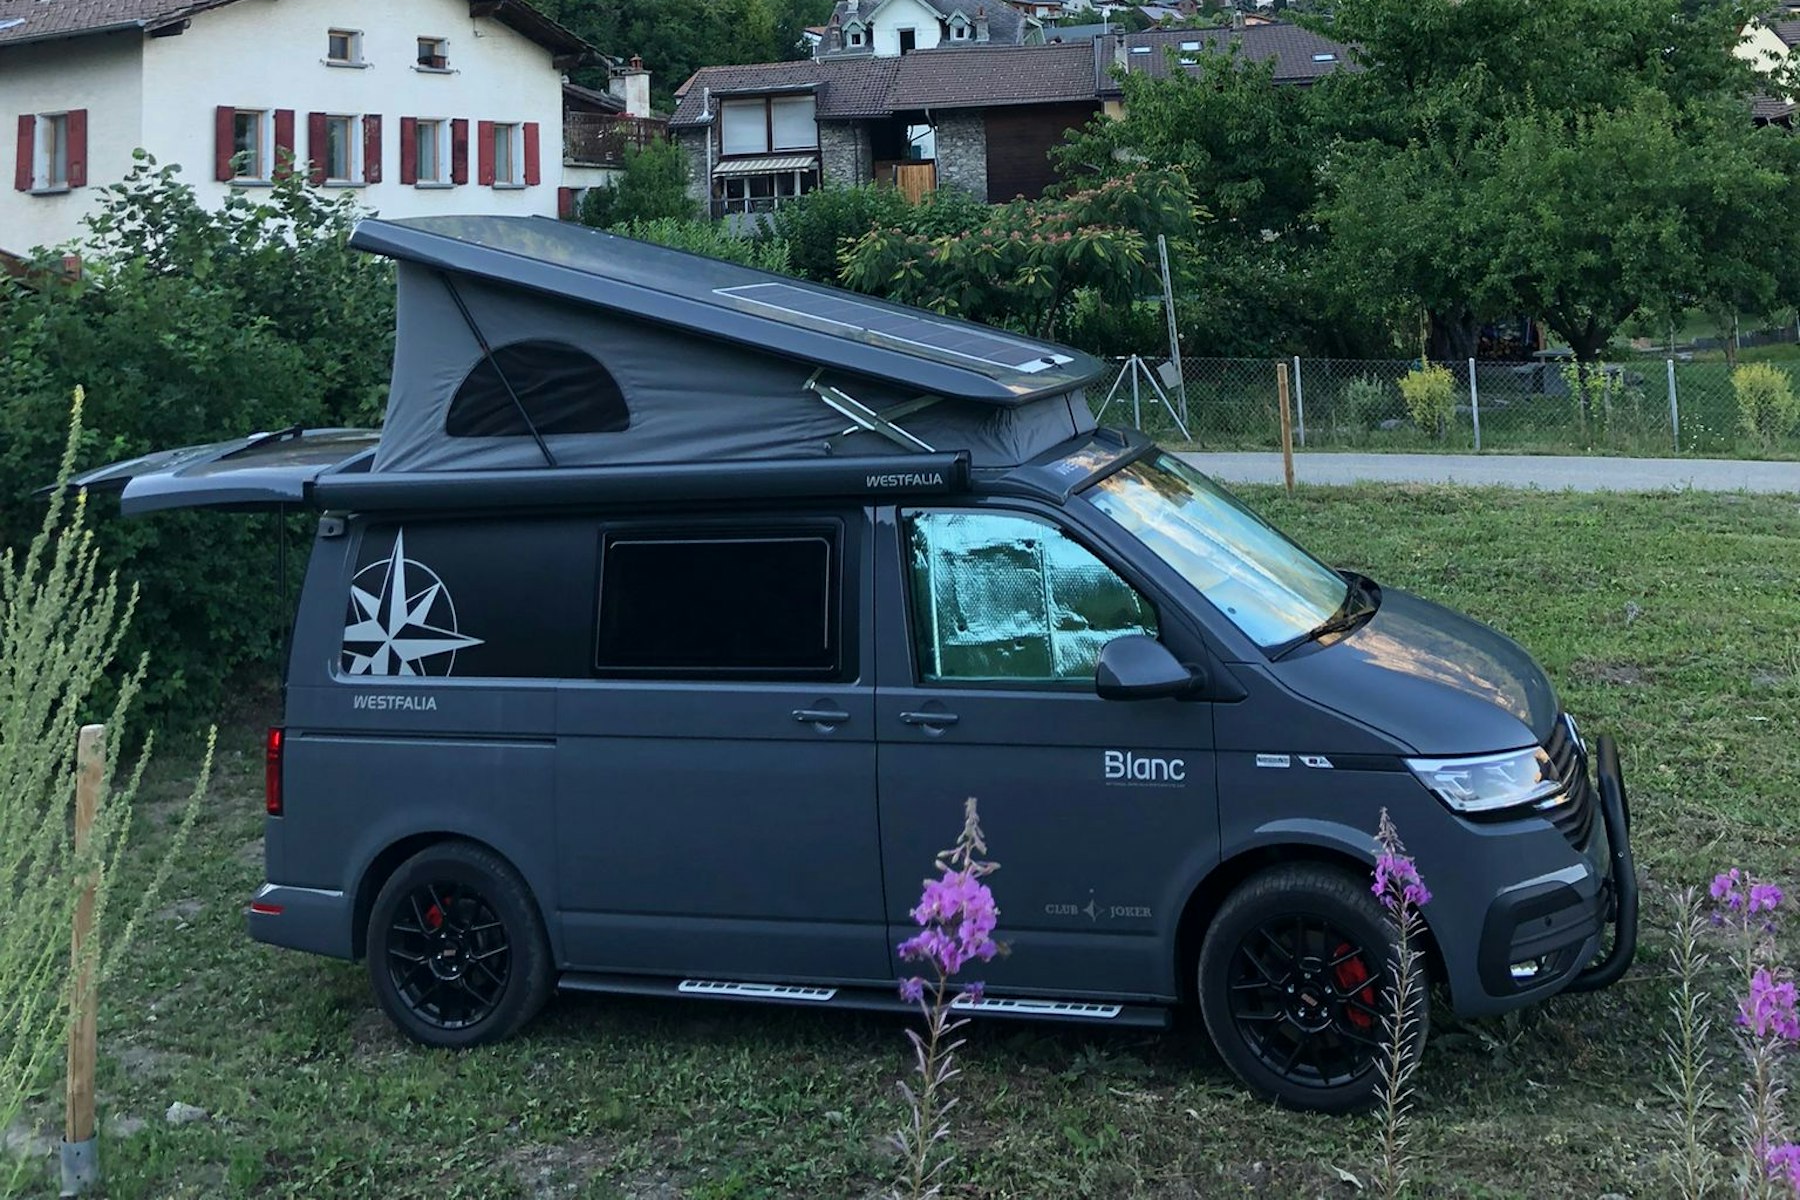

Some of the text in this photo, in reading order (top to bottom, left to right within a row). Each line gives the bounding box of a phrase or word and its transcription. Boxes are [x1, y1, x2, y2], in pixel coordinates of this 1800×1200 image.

[866, 473, 943, 488] WESTFALIA
[353, 695, 437, 710] WESTFALIA
[1105, 750, 1185, 780] Blanc
[1044, 904, 1153, 918] CLUB JOKER
